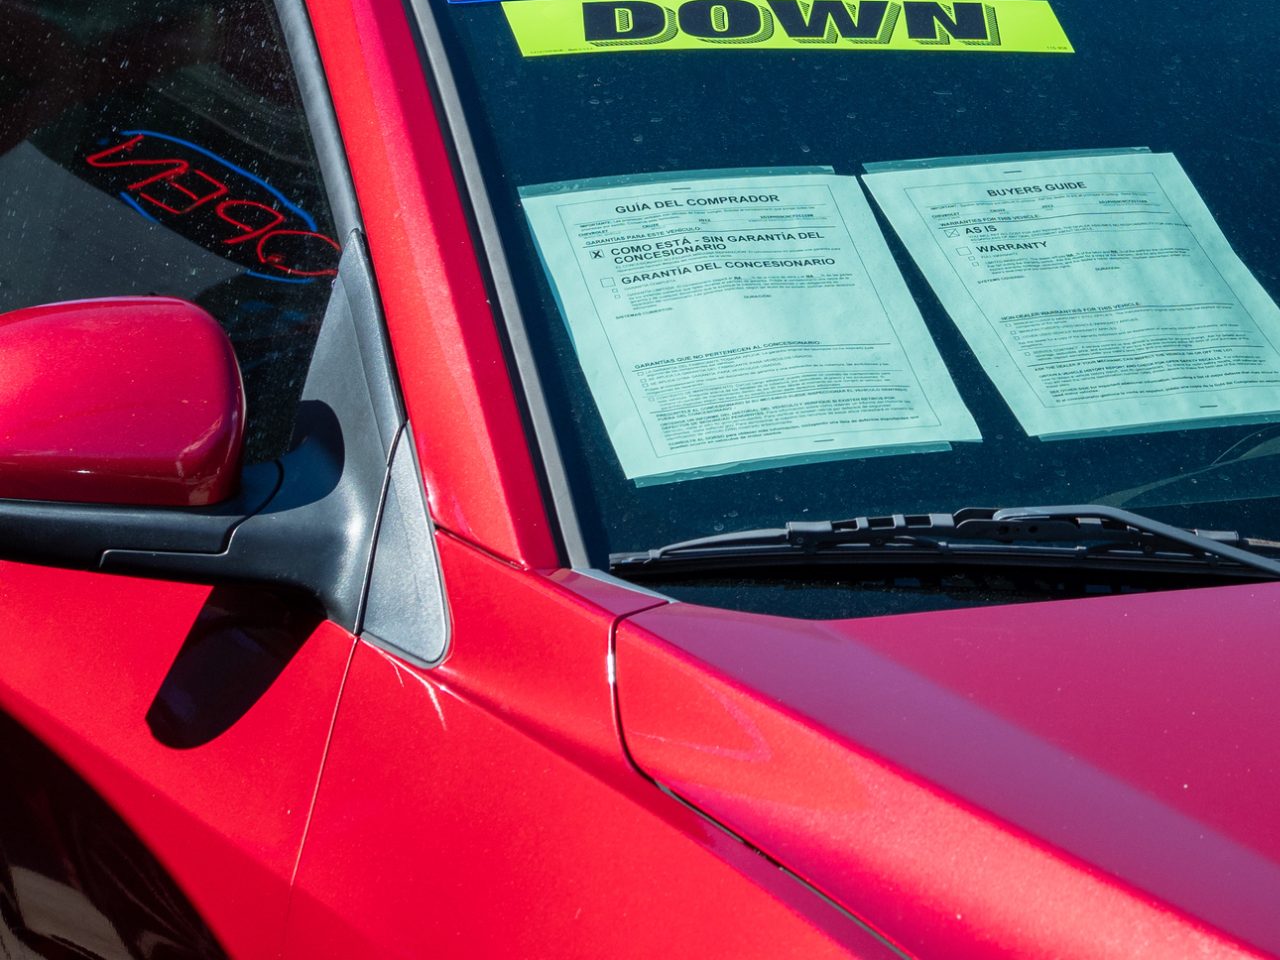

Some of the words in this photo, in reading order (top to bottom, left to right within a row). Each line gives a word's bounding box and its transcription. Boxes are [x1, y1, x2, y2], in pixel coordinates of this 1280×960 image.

[582, 0, 1002, 46] DOWN
[987, 185, 1042, 197] BUYERS
[1044, 181, 1087, 191] GUIDE
[615, 201, 652, 214] GUÍA
[654, 197, 683, 209] DEL
[686, 194, 780, 206] COMPRADOR
[610, 244, 652, 256] COMO
[656, 236, 692, 250] ESTÁ
[702, 236, 724, 244] SIN
[727, 232, 796, 243] GARANTÍA
[798, 232, 824, 240] DEL
[614, 243, 727, 264] CONCESIONARIO
[976, 241, 1048, 253] WARRANTY
[621, 266, 691, 285] GARANTÍA
[695, 260, 722, 272] DEL
[724, 258, 836, 269] CONCESIONARIO
